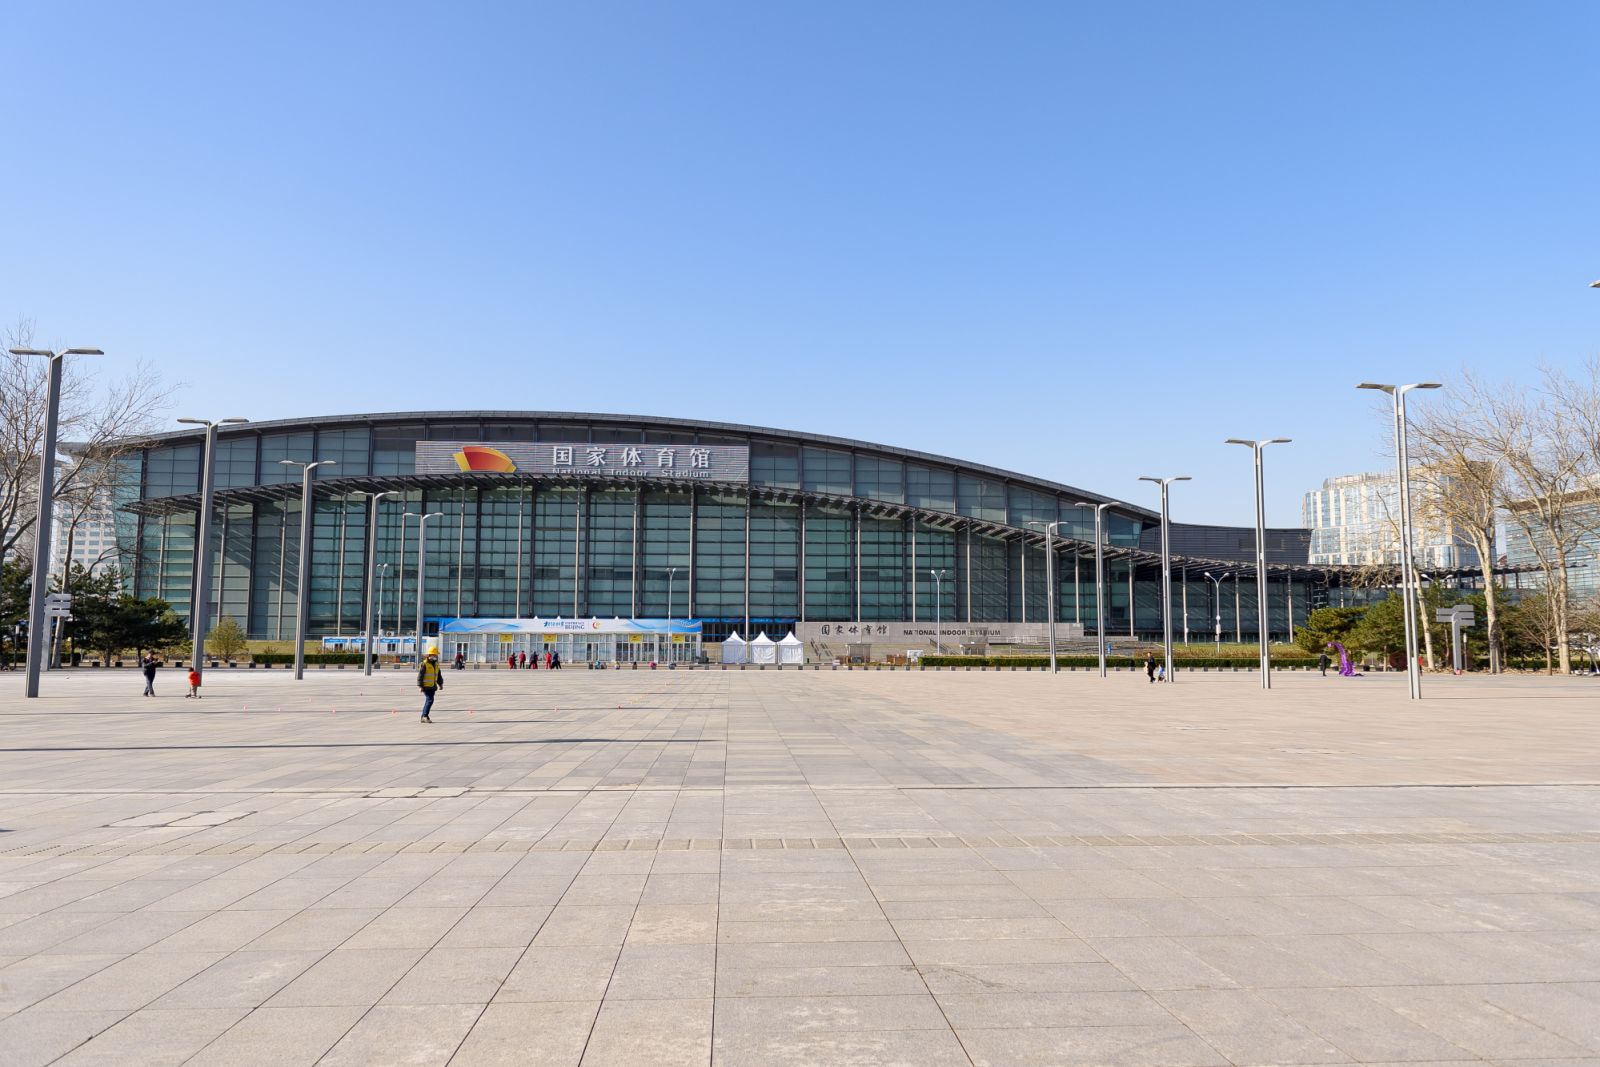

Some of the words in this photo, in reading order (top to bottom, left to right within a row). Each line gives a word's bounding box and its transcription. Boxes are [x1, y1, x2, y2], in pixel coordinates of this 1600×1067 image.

[552, 446, 711, 469] 国家体育馆
[610, 468, 648, 477] Indoor
[661, 469, 709, 478] Stadium
[821, 624, 888, 636] 国家体育馆
